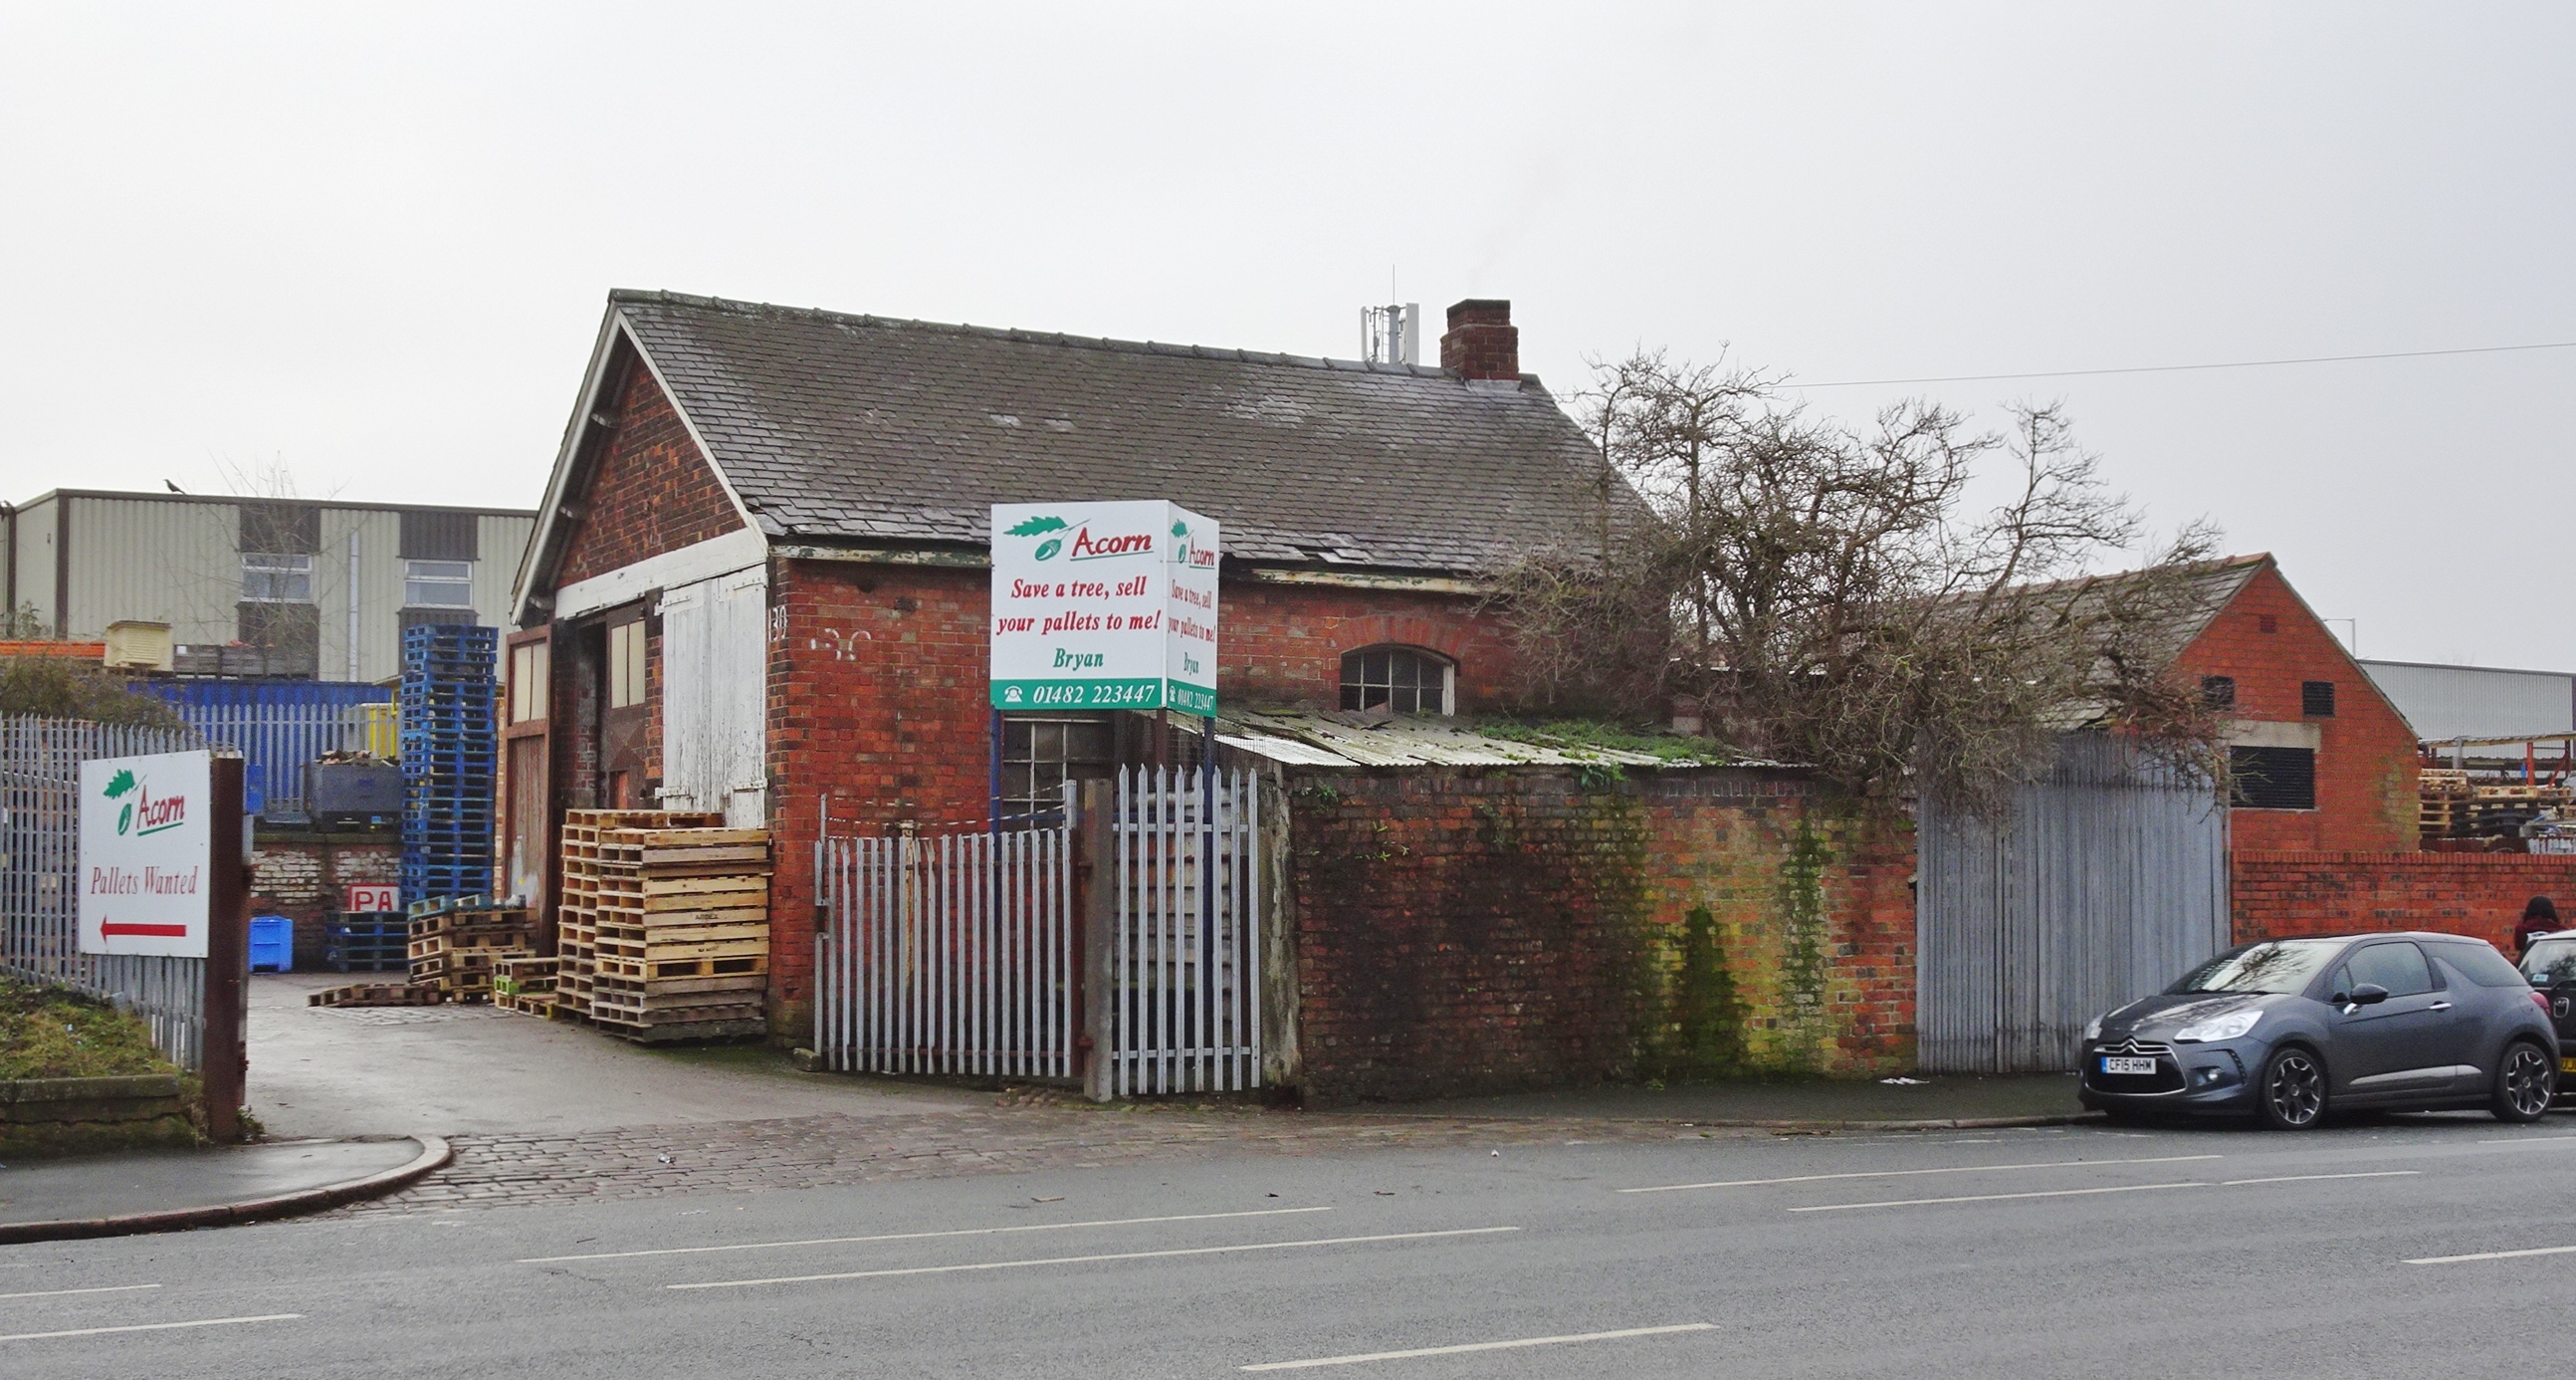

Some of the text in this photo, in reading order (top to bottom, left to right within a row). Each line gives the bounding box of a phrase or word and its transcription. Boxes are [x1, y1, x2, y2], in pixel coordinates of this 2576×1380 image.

[1072, 528, 1151, 557] Acorn
[1189, 537, 1214, 566] Acorn
[1011, 575, 1148, 600] Save a tree, sell
[1172, 578, 1183, 601] Save
[1202, 590, 1212, 609] sell
[996, 609, 1162, 635] your pallets to me!
[1168, 617, 1180, 634] your
[1181, 616, 1198, 638] pallets
[1053, 648, 1104, 671] Bryan
[1183, 651, 1199, 676] Bryan
[1033, 685, 1156, 704] 01482 223447
[1178, 688, 1214, 711] 01482 223447
[137, 785, 184, 828] Acorn
[91, 865, 198, 894] Pallets Wanted
